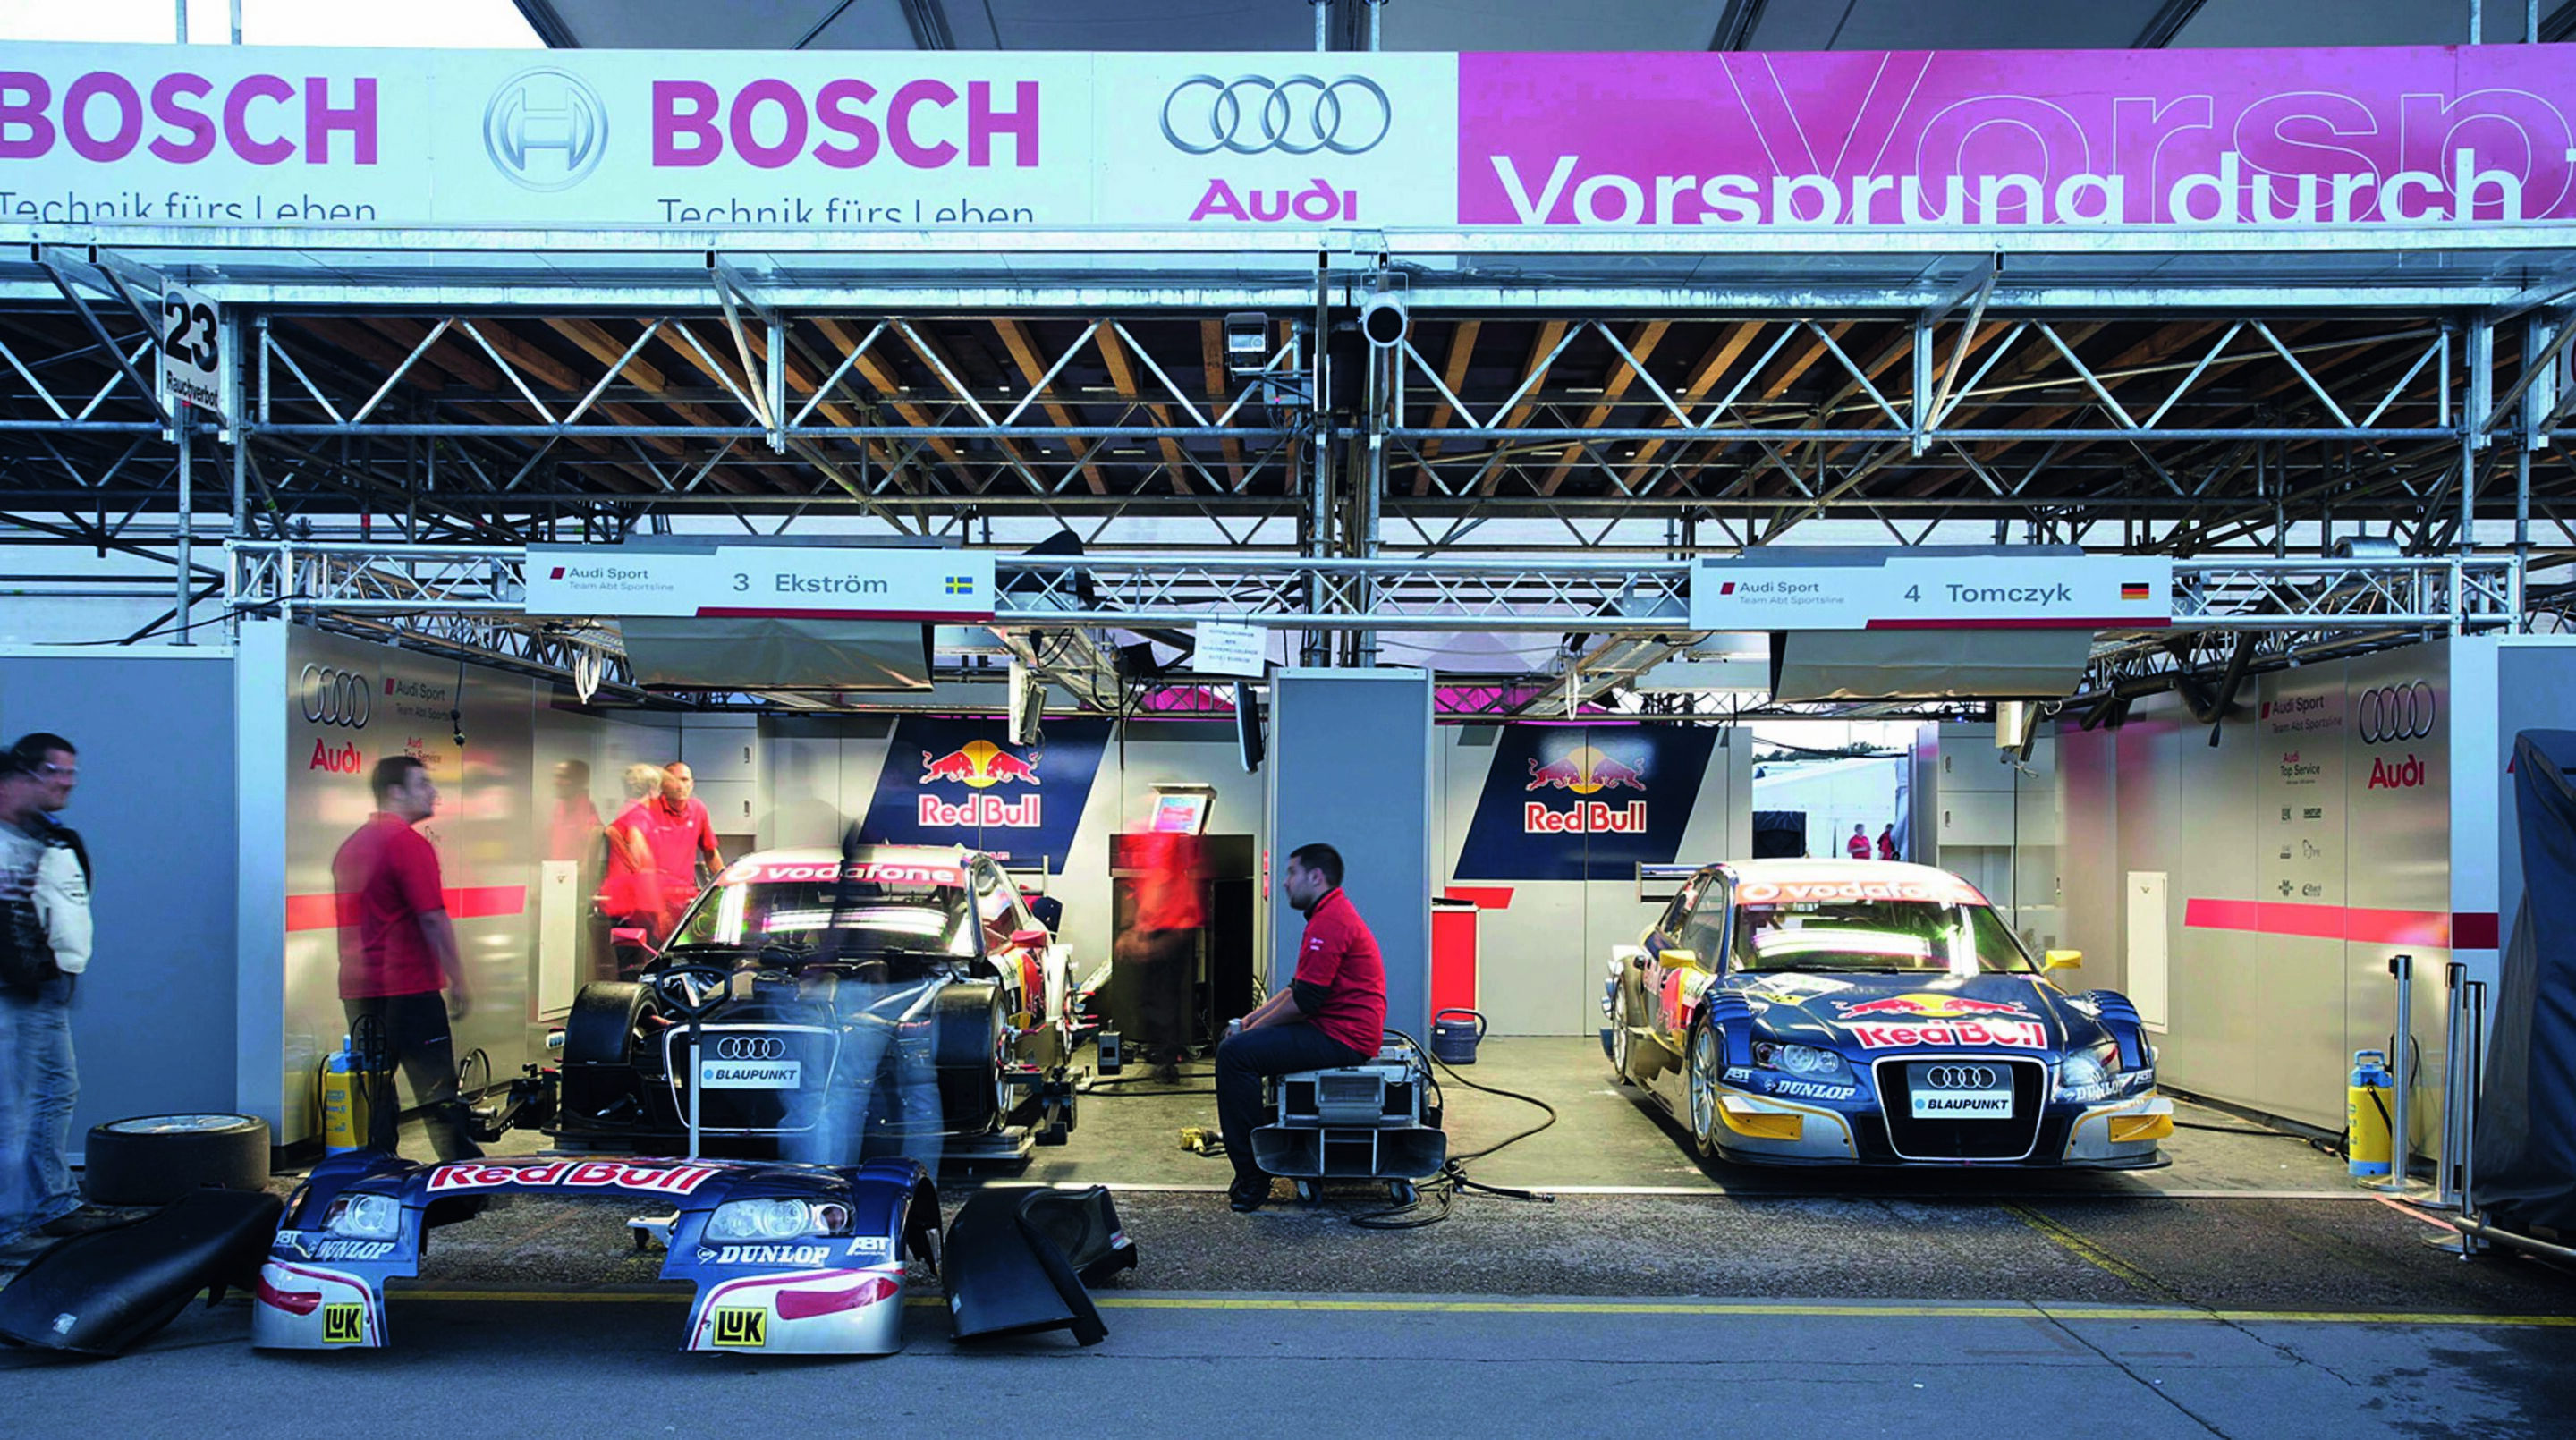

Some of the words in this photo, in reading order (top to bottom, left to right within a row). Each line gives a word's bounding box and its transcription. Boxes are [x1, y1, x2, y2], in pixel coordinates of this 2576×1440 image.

[0, 72, 377, 165] BOSCH
[652, 79, 1038, 168] BOSCH
[1489, 155, 2124, 224] Vorsprung
[2169, 148, 2521, 224] durch
[0, 191, 153, 223] Technik
[165, 192, 242, 220] fürs
[657, 198, 814, 223] Technik
[826, 198, 902, 223] fürs
[1188, 179, 1357, 222] Audi
[165, 291, 218, 373] 23
[166, 369, 218, 408] Rauchverbot
[568, 581, 596, 590] Team
[597, 581, 619, 590] Abt
[620, 581, 675, 593] Sportsline
[569, 566, 604, 580] Audi
[606, 566, 649, 582] Sport
[733, 573, 750, 592] 3
[775, 572, 889, 594] Ekström
[1739, 581, 1775, 595] Audi
[1777, 581, 1820, 597] Sport
[1739, 597, 1767, 606] Team
[1767, 596, 1790, 606] Abt
[1790, 596, 1845, 606] Sportsline
[1903, 583, 1922, 603] 4
[1945, 582, 2072, 608] Tomczyk
[396, 680, 418, 698] Audi
[419, 683, 445, 702] Sport
[2272, 700, 2295, 715] Audi
[2296, 696, 2325, 715] Sport
[2272, 723, 2290, 733] Team
[309, 737, 361, 774] Audi
[2294, 762, 2320, 776] Service
[2368, 754, 2425, 790] Audi
[919, 794, 979, 826] Red
[983, 794, 1040, 826] Bull
[1525, 800, 1585, 833] Red
[1588, 800, 1647, 833] Bull
[767, 864, 956, 883] vodafone
[1852, 1019, 1955, 1049] Red
[716, 1068, 798, 1080] BLAUPUNKT
[1723, 1067, 1754, 1080] ABT
[1775, 1080, 1856, 1101] DUNLOP
[1928, 1098, 2009, 1110] BLAUPUNKT
[427, 1162, 575, 1191] Red
[563, 1162, 720, 1195] Bull
[314, 1238, 395, 1260] DUNLOP
[716, 1245, 831, 1264] DUNLOP
[845, 1236, 890, 1256] ABT
